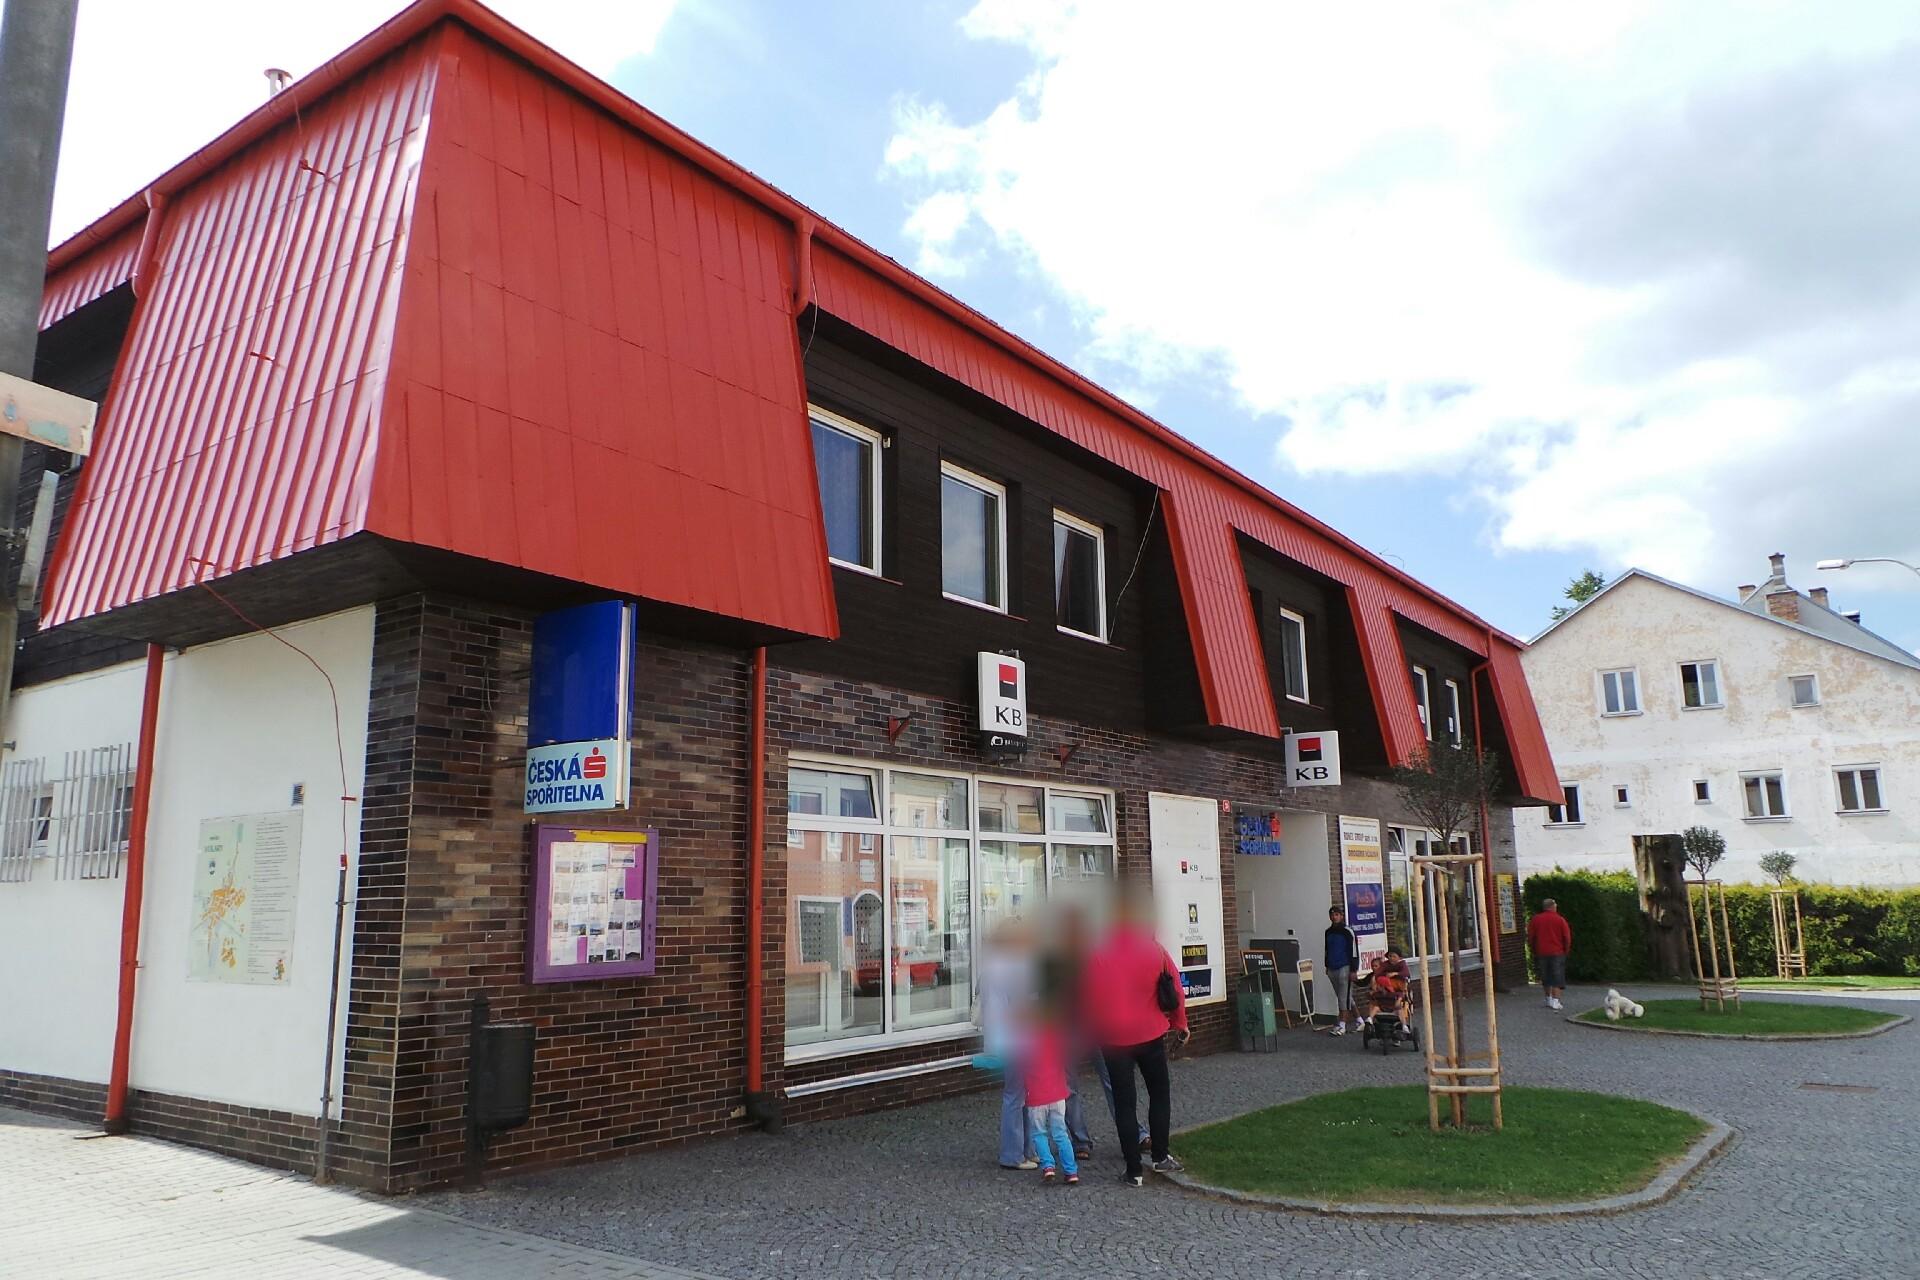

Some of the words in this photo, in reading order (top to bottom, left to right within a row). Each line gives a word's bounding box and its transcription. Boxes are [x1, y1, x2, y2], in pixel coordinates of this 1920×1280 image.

[995, 705, 1022, 727] KB
[528, 752, 582, 785] ČESKÁ
[1295, 766, 1329, 781] KB
[526, 783, 605, 806] SPOŘITELNA
[1189, 864, 1199, 872] KB
